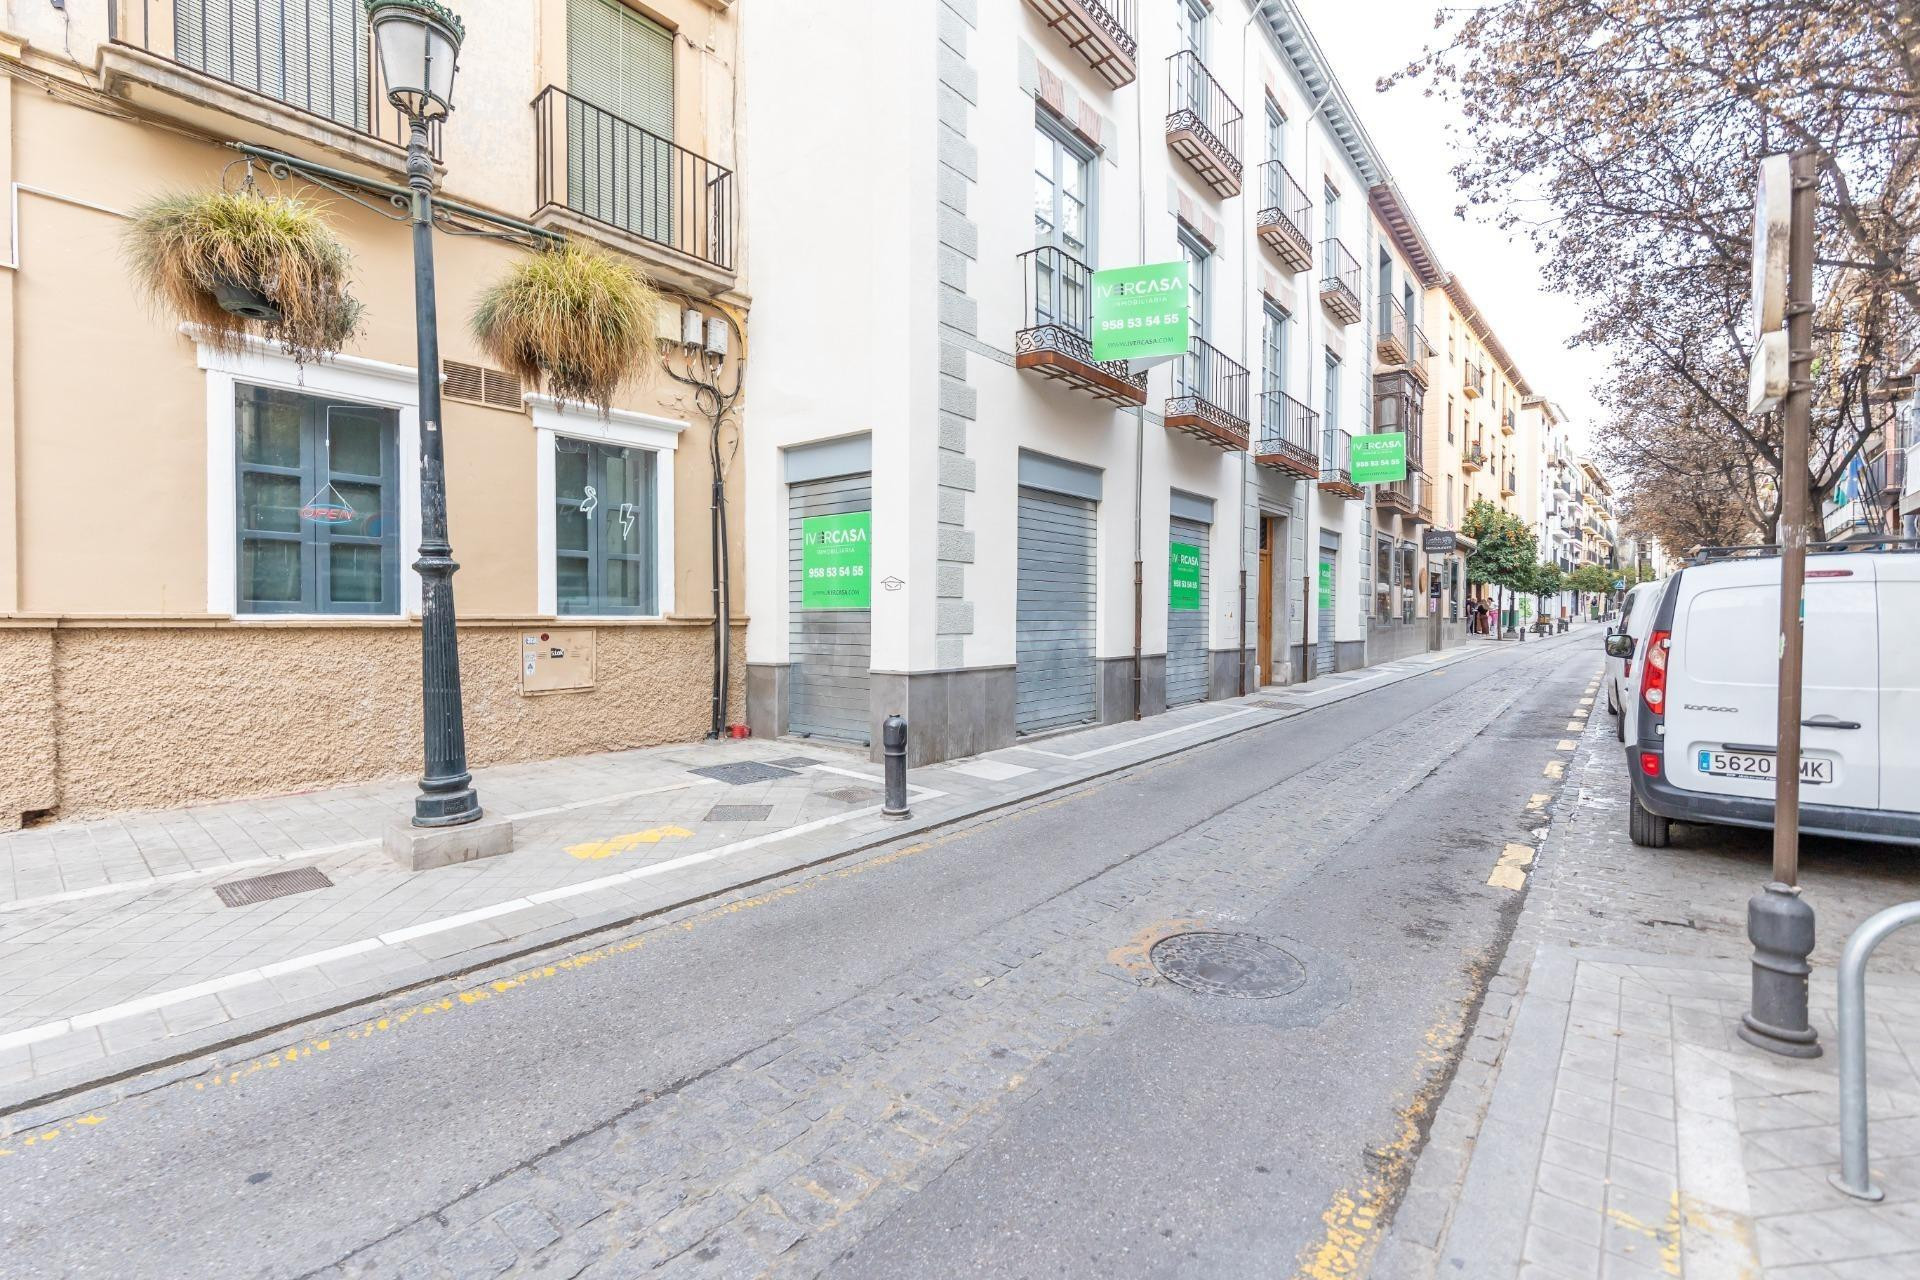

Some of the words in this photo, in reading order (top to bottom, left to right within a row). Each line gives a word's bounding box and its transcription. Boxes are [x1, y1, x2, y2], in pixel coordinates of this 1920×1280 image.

[1097, 277, 1183, 298] IVERCASA
[1102, 320, 1123, 331] 958
[1127, 317, 1141, 328] 53
[1145, 315, 1160, 327] 54
[1164, 313, 1179, 324] 55
[303, 507, 352, 519] OPEN
[806, 528, 866, 545] IVERCASA
[809, 568, 824, 578] 958
[827, 567, 837, 577] 53
[839, 566, 850, 576] 54
[852, 565, 864, 576] 55
[1714, 754, 1771, 773] 5620
[1800, 761, 1824, 778] MK
